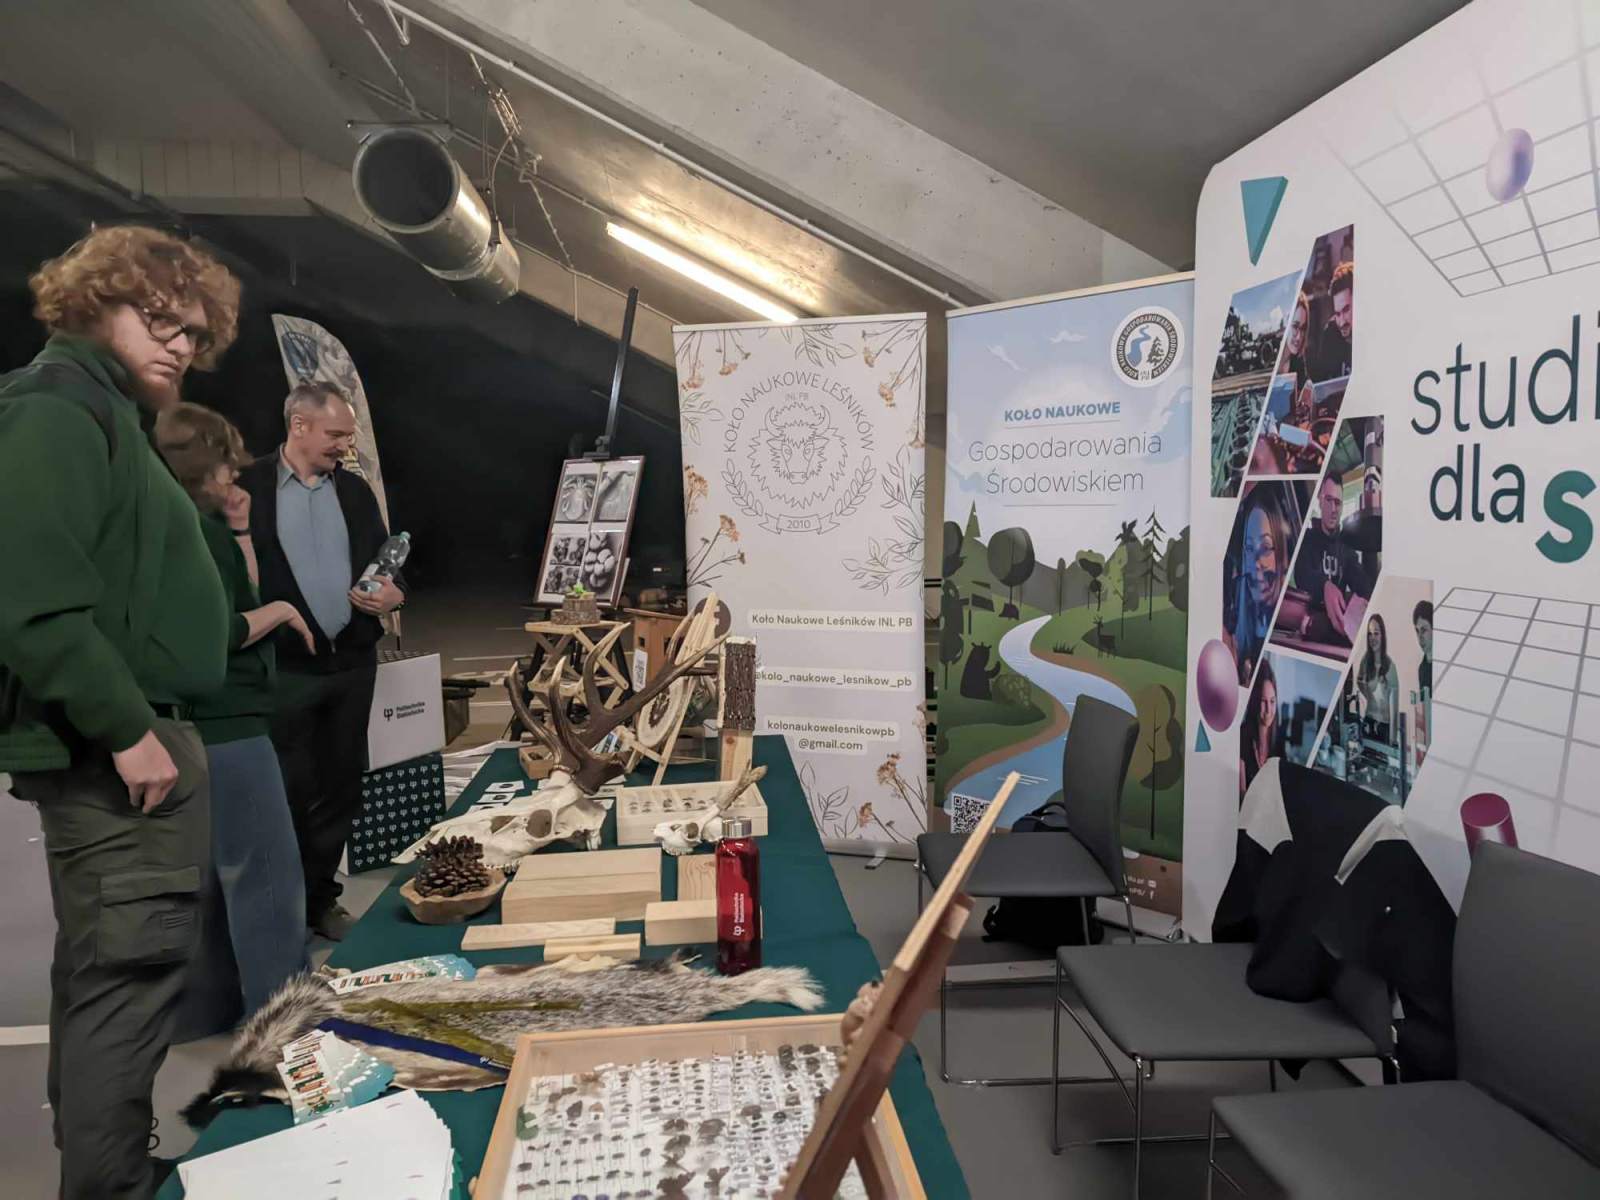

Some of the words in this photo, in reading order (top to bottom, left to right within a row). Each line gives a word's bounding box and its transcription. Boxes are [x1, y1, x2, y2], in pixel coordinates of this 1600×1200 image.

[724, 407, 745, 453] KOŁO
[741, 370, 820, 408] NAUKOWE
[821, 379, 875, 451] LEŚNIKÓW
[1004, 406, 1042, 422] KOŁO
[1046, 401, 1121, 419] NAUKOWE
[968, 431, 1162, 464] Gospodarowania
[986, 466, 1144, 495] Środowiskiem
[1429, 443, 1525, 523] dla
[786, 519, 811, 530] 2010
[752, 614, 774, 625] Koło
[777, 615, 824, 626] Naukowe
[827, 615, 876, 627] Leśników
[878, 617, 896, 628] INL
[899, 617, 913, 627] PB
[767, 720, 895, 738] kolonaukowelesnikowpb
[798, 738, 863, 751] @gmail.com
